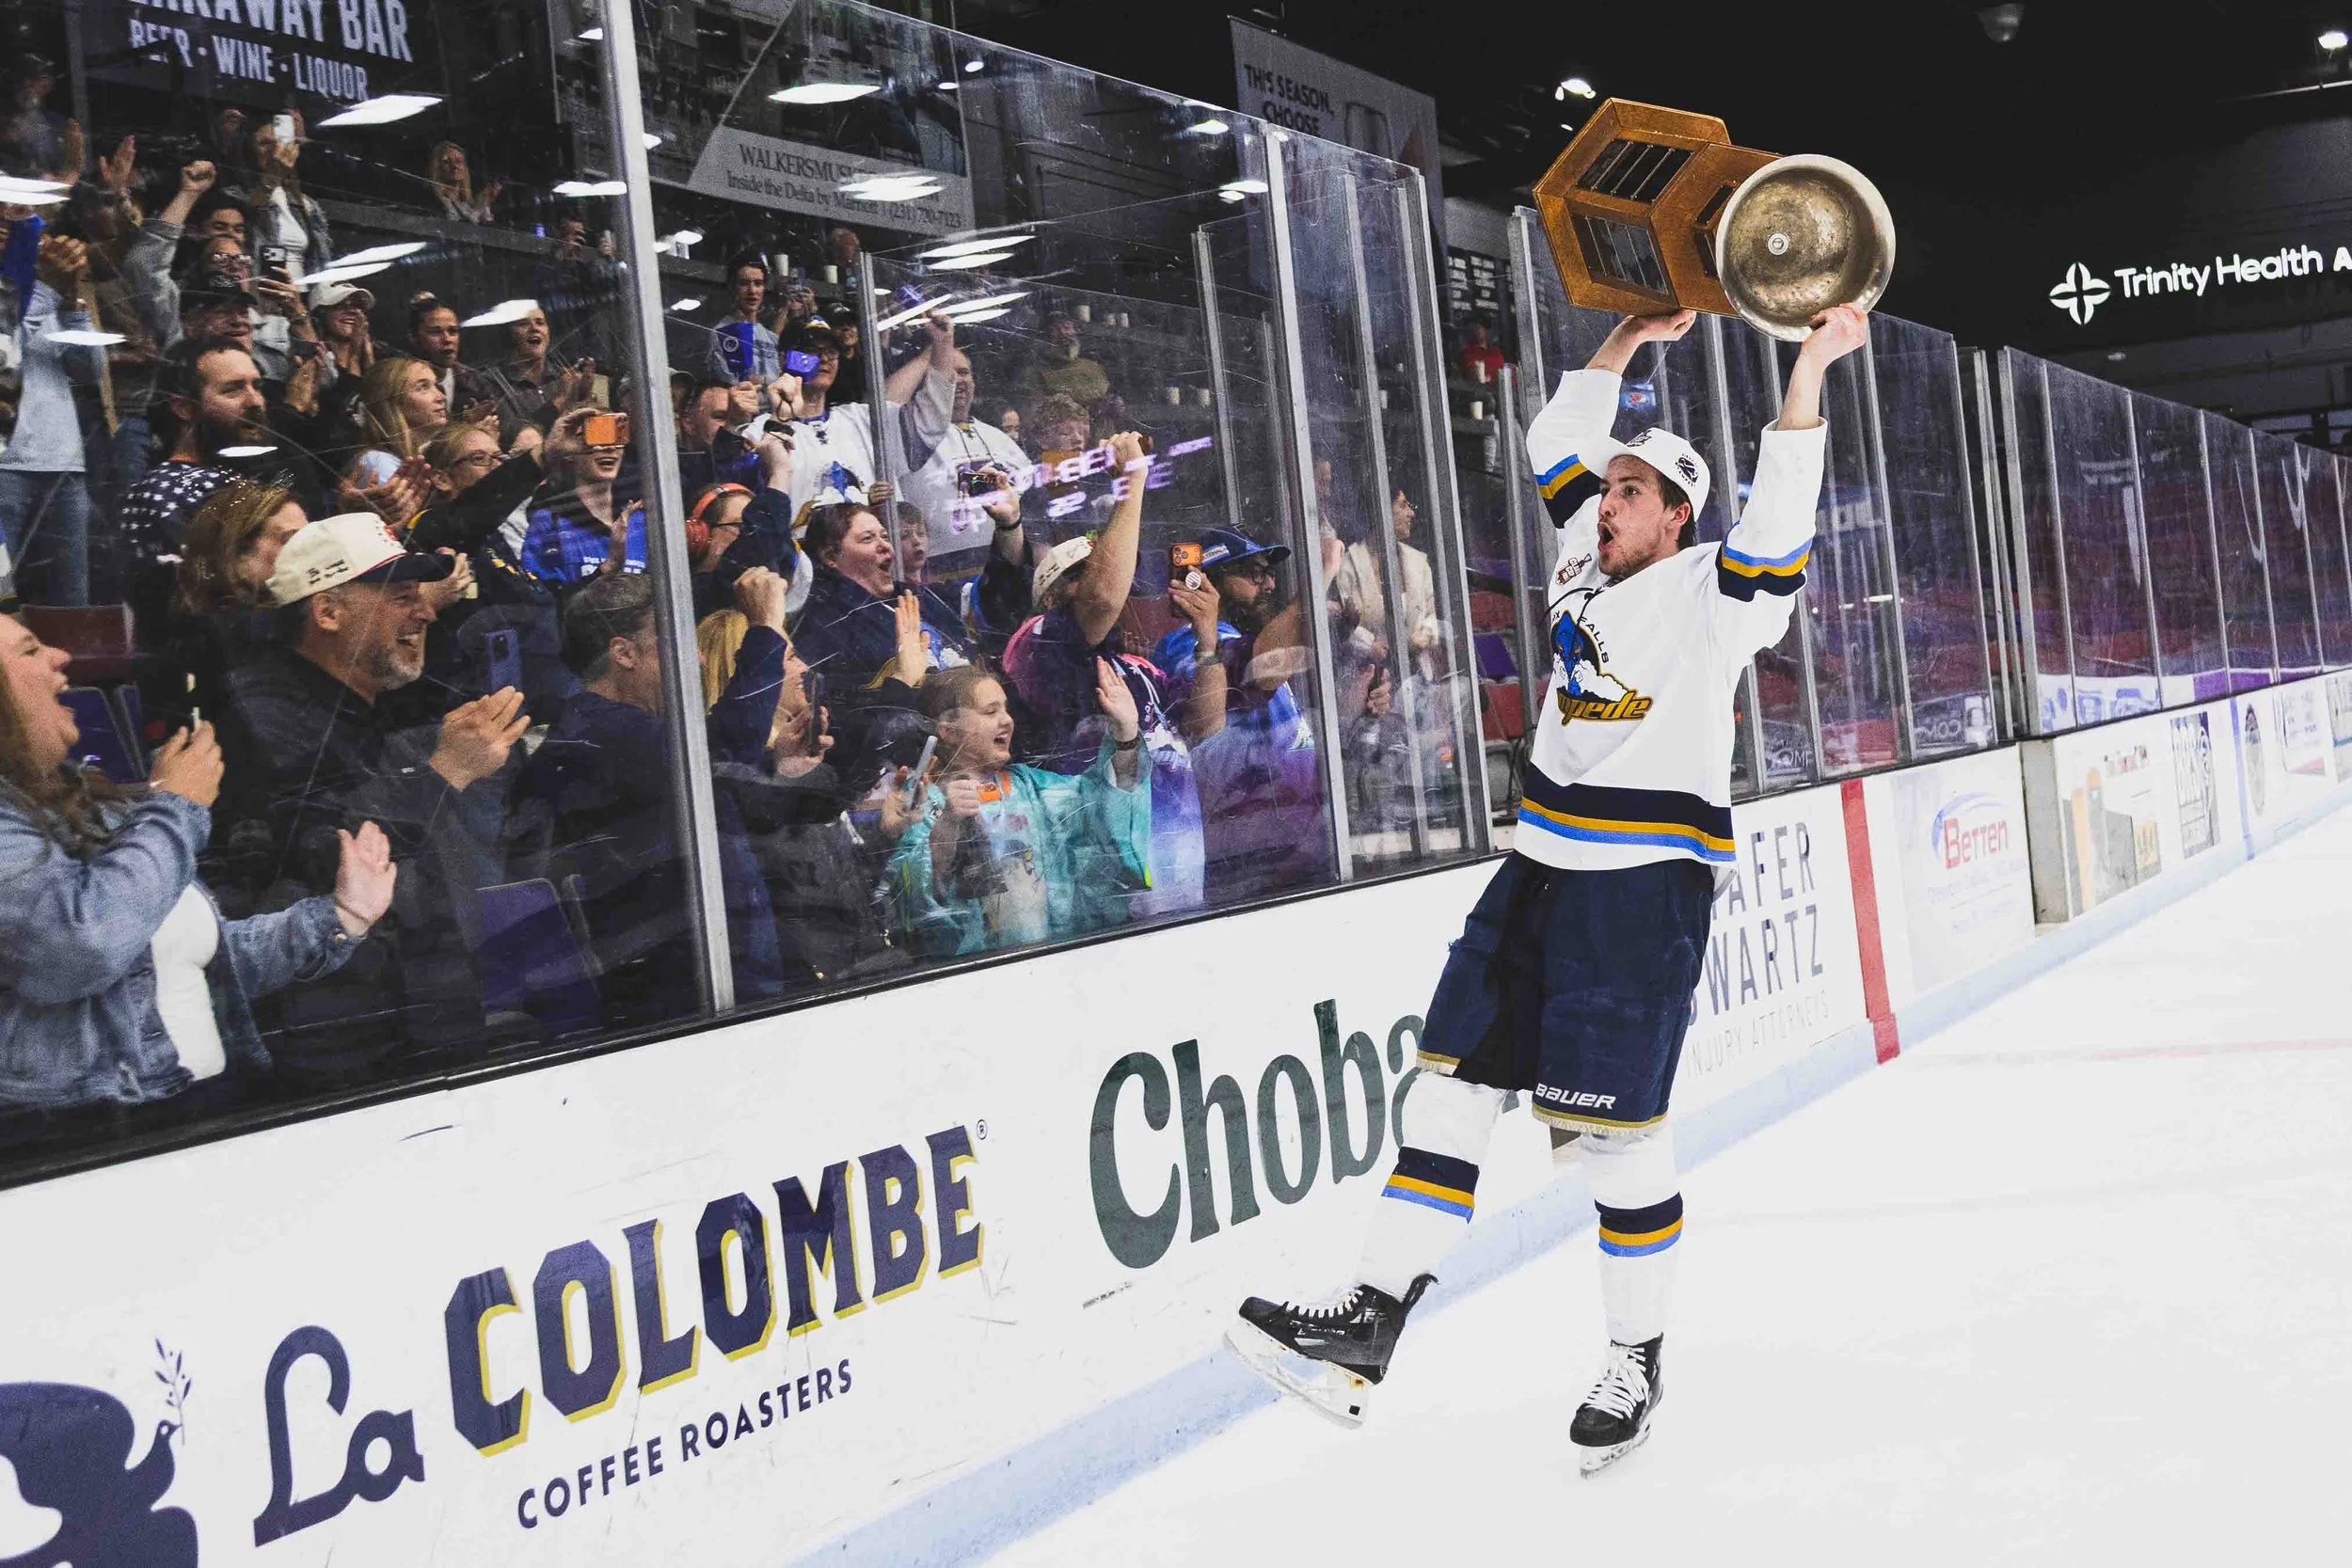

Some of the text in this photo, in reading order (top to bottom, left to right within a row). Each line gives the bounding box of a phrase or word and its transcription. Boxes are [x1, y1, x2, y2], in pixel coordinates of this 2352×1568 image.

[339, 0, 413, 63] BAR
[212, 35, 276, 83] WINE
[293, 53, 369, 101] LIQUOR
[1245, 64, 1273, 92] THIS
[1263, 101, 1320, 135] CHOOSE
[726, 170, 764, 193] Inside
[764, 179, 783, 198] the
[785, 182, 815, 203] Delta
[816, 188, 832, 208] by
[2114, 262, 2210, 297] Trinity
[2216, 245, 2324, 285] Health
[1578, 616, 1610, 664] FALLS
[1712, 822, 1815, 920] AFER
[1690, 904, 1822, 1026] WARTZ
[253, 1124, 984, 1547] La COLOMBE
[517, 1358, 852, 1529] COFFEE ROASTERS
